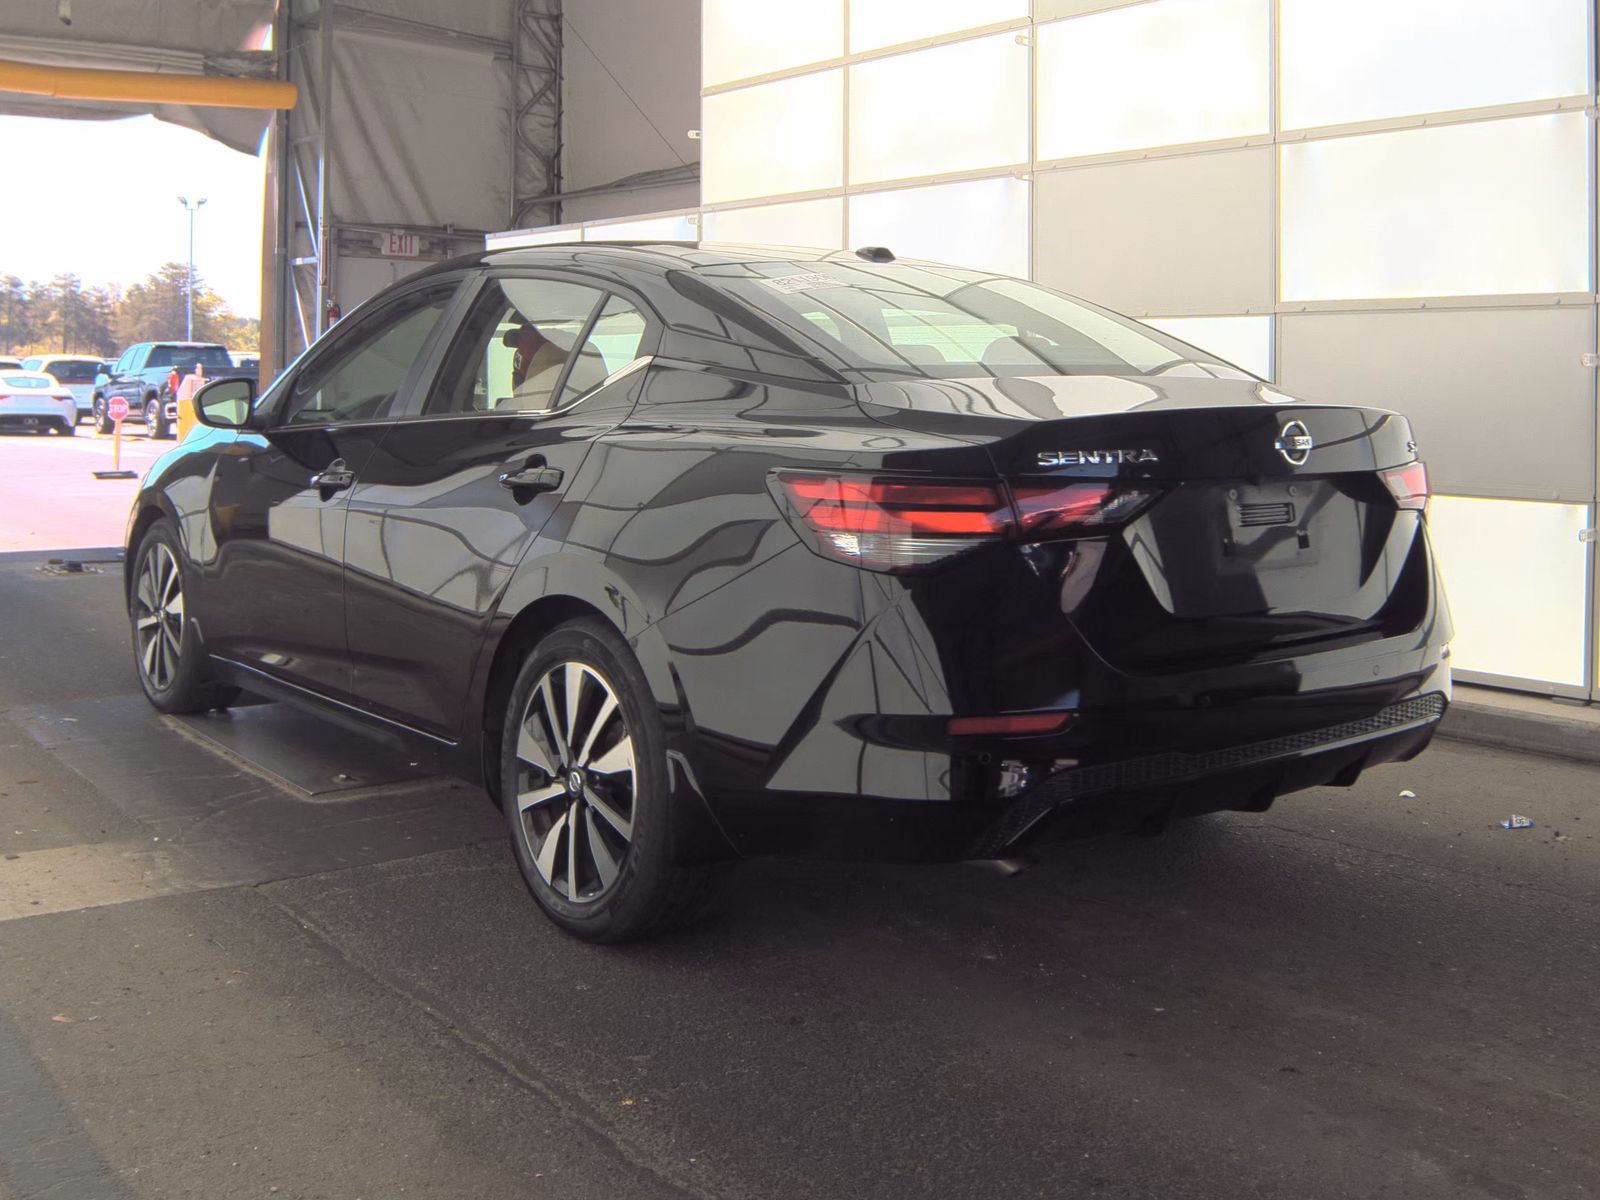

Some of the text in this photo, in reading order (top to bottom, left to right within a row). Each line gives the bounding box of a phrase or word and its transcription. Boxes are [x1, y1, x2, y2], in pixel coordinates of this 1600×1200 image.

[390, 235, 413, 254] EXIT
[108, 403, 128, 414] STOP
[1037, 448, 1159, 466] SENTRA
